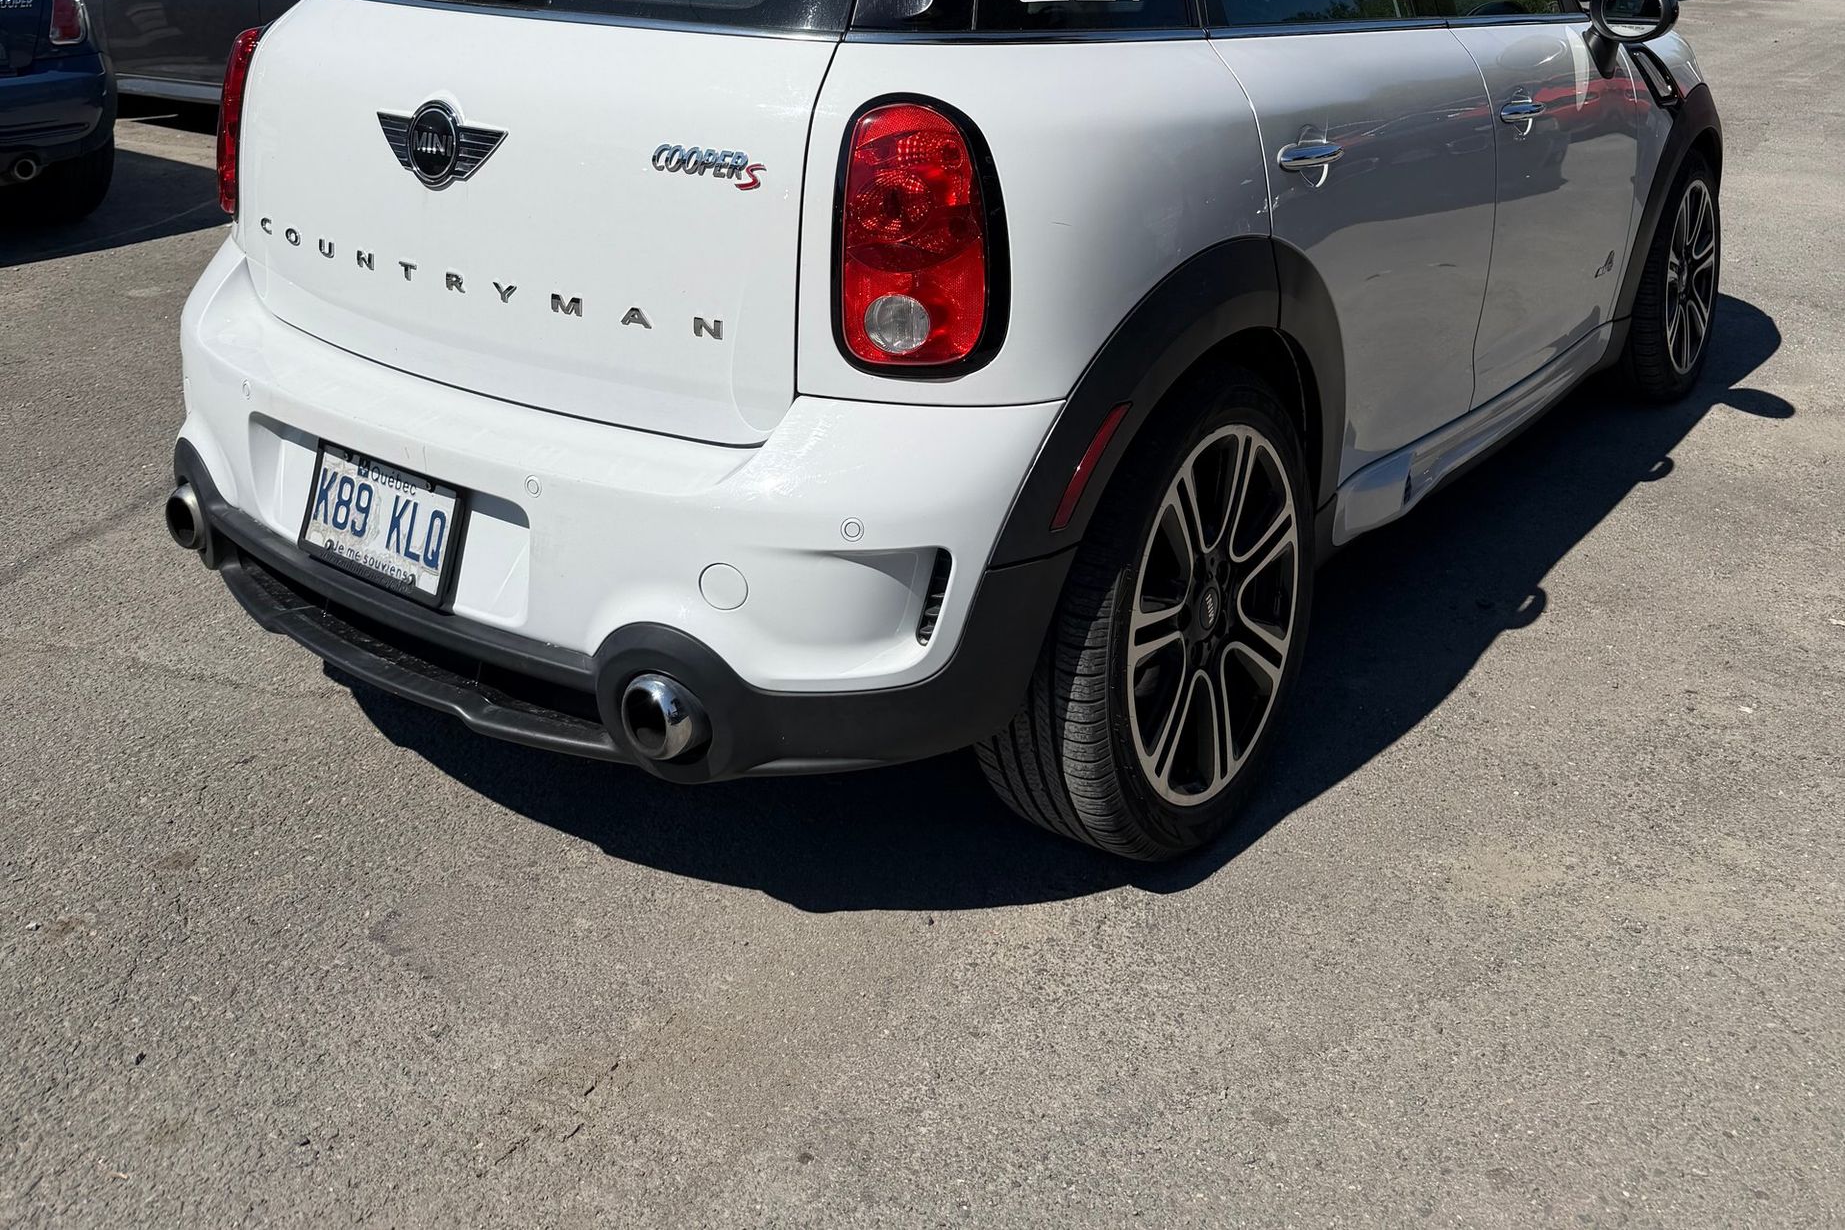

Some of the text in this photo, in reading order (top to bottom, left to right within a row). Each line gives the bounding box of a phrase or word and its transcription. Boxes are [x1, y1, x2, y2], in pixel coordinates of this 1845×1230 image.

[412, 130, 453, 158] MINI
[260, 216, 723, 340] COUNTRYMAN
[370, 465, 418, 497] Québec
[312, 467, 447, 571] K89 KLQ
[331, 540, 408, 582] Je me souviens
